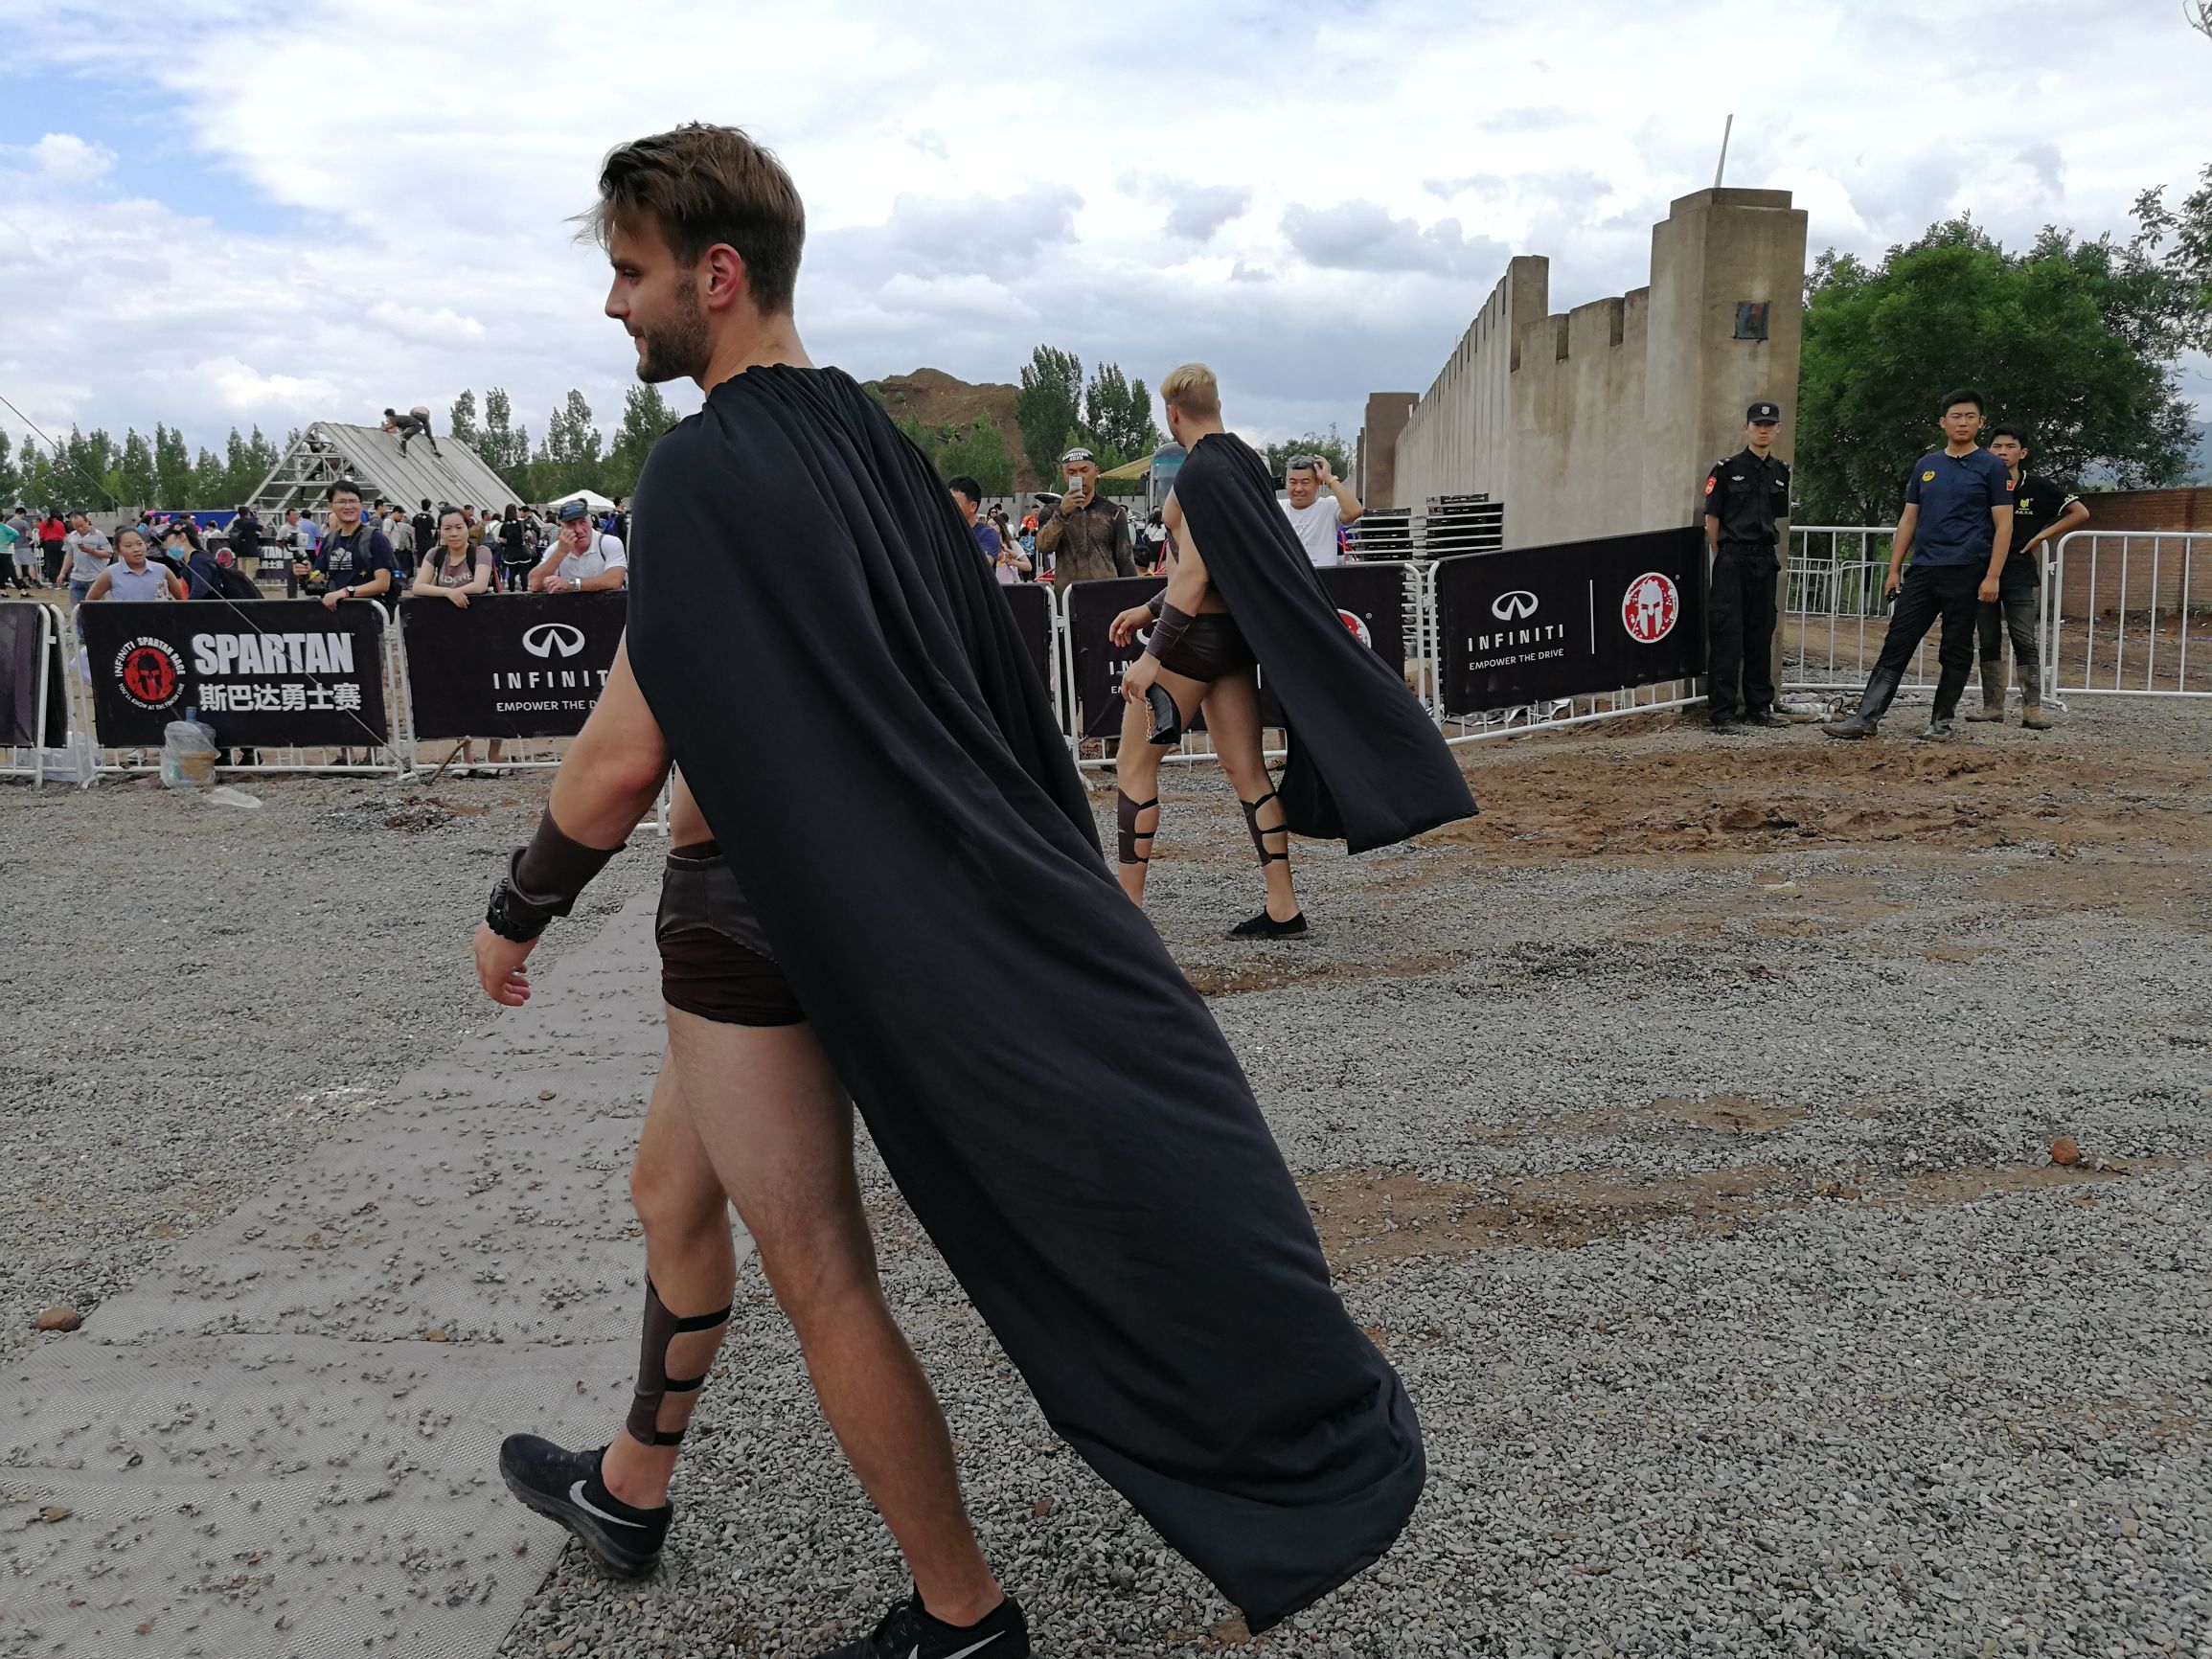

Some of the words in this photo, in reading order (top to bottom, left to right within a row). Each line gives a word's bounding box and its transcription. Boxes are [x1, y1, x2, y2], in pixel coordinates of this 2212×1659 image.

[1468, 624, 1563, 652] INFINITI
[114, 640, 136, 677] INFINITI
[137, 636, 174, 656] SPARTAN
[170, 652, 187, 675] RACE
[192, 632, 354, 675] SPARTAN
[1469, 656, 1516, 670] EMPOWER
[1518, 652, 1536, 663] THE
[1538, 648, 1564, 660] DRIVE
[492, 670, 609, 690] INFINIT
[131, 698, 148, 709] KNOW
[198, 682, 362, 712] 斯巴达勇士赛
[496, 701, 559, 712] EMPOWER
[561, 700, 586, 710] THE
